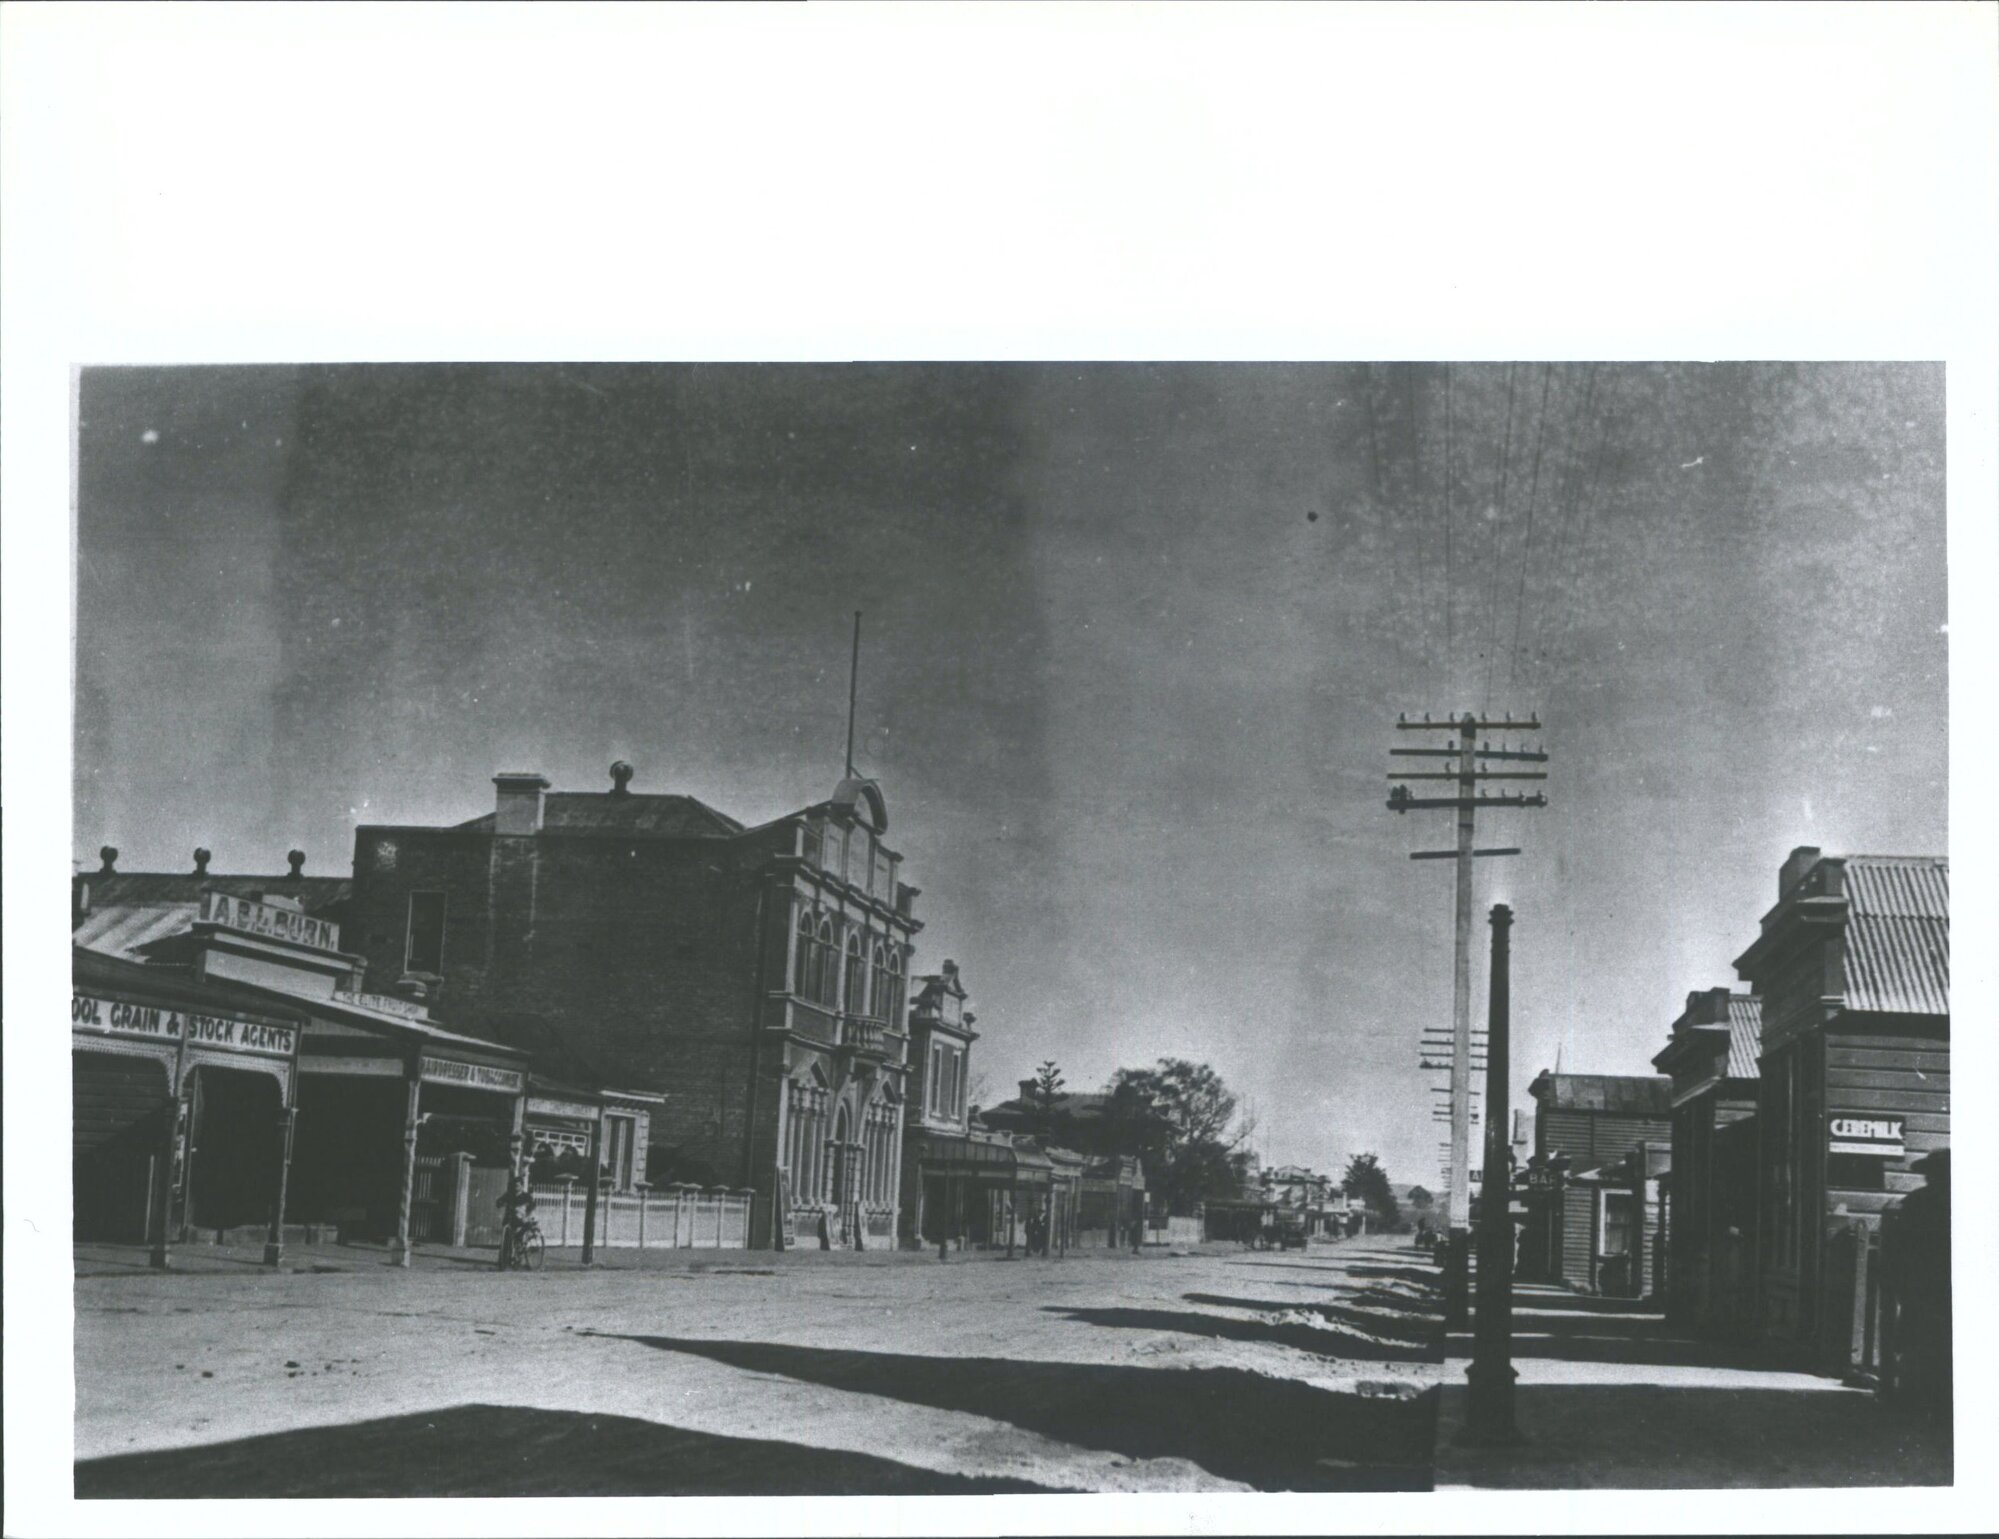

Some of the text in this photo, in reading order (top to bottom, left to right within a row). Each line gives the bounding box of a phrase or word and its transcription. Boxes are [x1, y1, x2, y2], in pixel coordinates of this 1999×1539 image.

[110, 1002, 161, 1034] GRAIN
[166, 1012, 180, 1036] &
[188, 1015, 292, 1052] STOCK AGENTS
